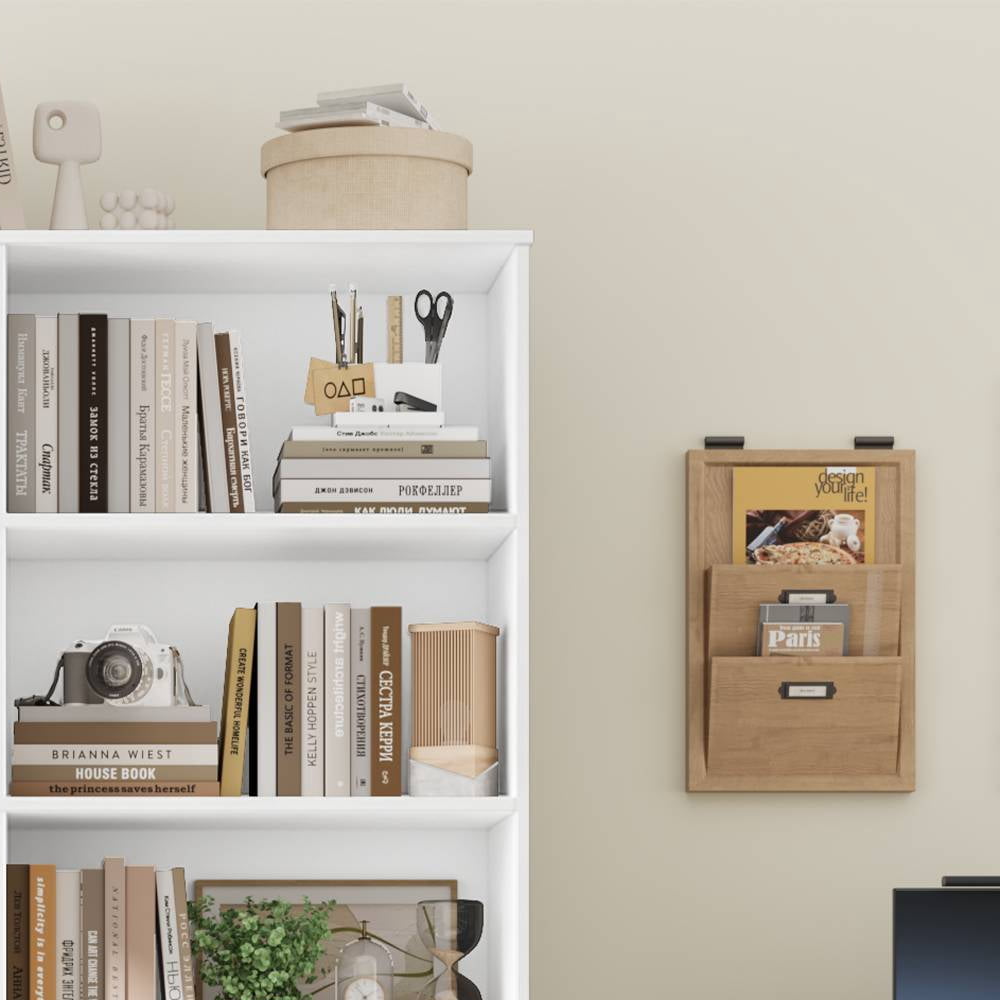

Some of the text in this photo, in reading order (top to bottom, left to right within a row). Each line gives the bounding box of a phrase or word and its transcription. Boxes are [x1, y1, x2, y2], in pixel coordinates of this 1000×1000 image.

[16, 333, 28, 413] Иммануил Кант
[16, 430, 27, 496] ТРАКТАТЫ
[89, 406, 98, 502] замок из стекла
[138, 405, 150, 506] Братья Карамазовы
[180, 406, 190, 504] Маленькие женщины
[237, 396, 253, 494] ГОВОРИ КАК БОГ
[40, 444, 54, 494] Спартак
[225, 428, 240, 508] Бархатная смерть
[818, 468, 865, 486] design
[314, 486, 374, 494] ДЖОН ДЭВИСОН
[398, 484, 464, 496] РОКФЕЛЛЕР
[814, 481, 844, 498] your
[843, 487, 868, 503] life!
[768, 630, 821, 648] Paris
[230, 648, 248, 755] CREATE WONDERFUL HOMELIFE
[284, 643, 294, 755] THE BASIC OF FORMAT
[308, 651, 318, 766] KELLY HOPPEN STYLE
[356, 674, 366, 757] СТИХОТВОРЕНИЯ
[379, 670, 392, 762] СЕСТРА КЕРРИ
[52, 750, 172, 760] BRIANNA WIEST
[76, 768, 156, 780] HOUSE BOOK
[34, 876, 46, 934] simplicity
[34, 938, 46, 948] is
[88, 930, 98, 944] CAN
[179, 912, 188, 949] РОСС
[34, 951, 46, 962] in
[62, 940, 74, 976] ФРИДРИХ
[88, 946, 98, 958] ART
[88, 959, 98, 984] CHANGE
[88, 986, 98, 997] THE
